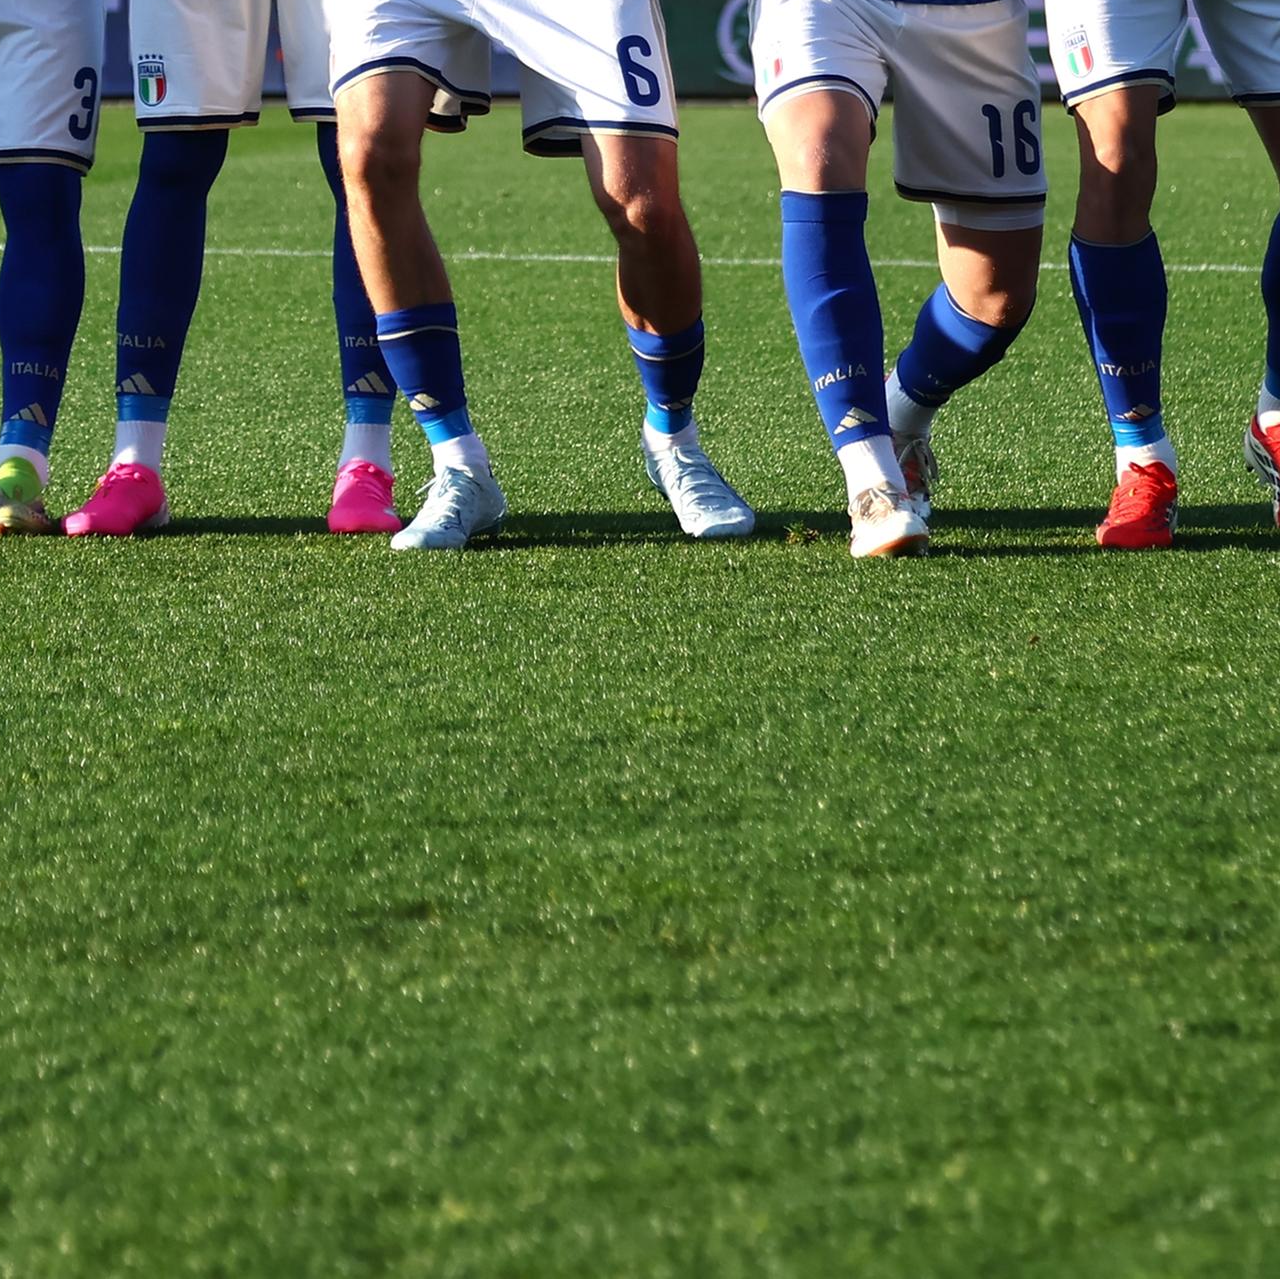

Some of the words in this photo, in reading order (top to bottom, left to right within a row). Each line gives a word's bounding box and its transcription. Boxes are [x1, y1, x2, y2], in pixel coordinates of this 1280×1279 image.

[617, 35, 660, 106] 6
[69, 67, 97, 140] 3
[982, 99, 1040, 178] 16
[118, 333, 165, 349] TALIA
[11, 362, 60, 380] ITALIA
[815, 363, 867, 392] ITALIA
[1100, 360, 1156, 376] ITALIA
